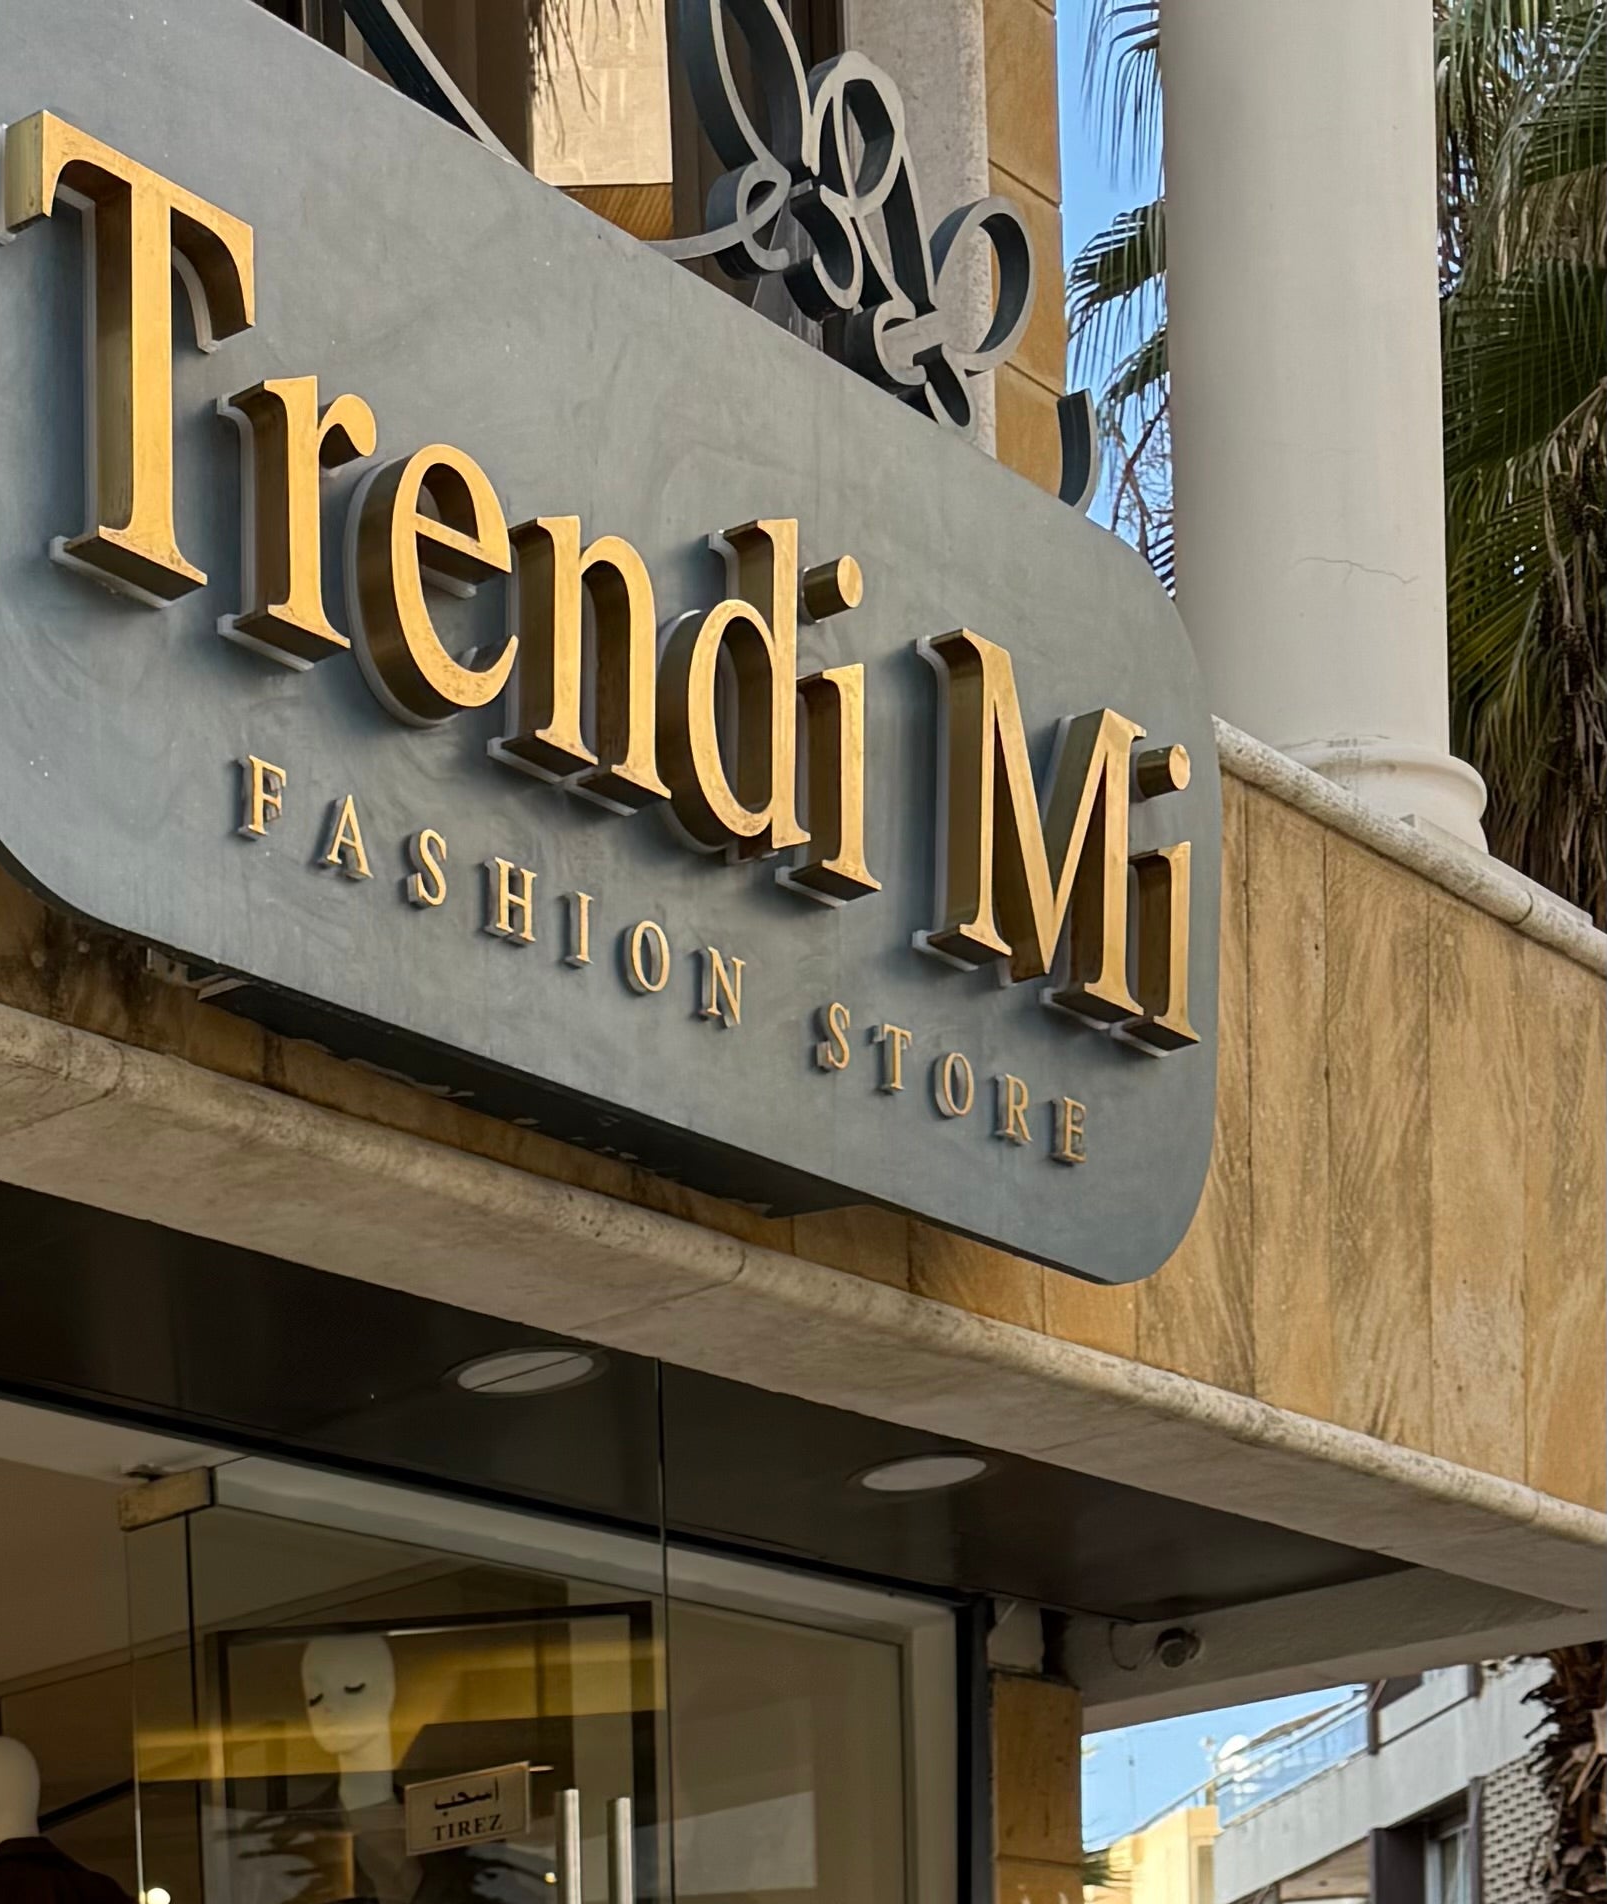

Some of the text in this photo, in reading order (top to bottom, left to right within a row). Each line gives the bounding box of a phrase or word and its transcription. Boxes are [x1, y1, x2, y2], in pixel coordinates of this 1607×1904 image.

[917, 628, 1200, 1052] Mi
[239, 755, 1087, 1164] FASHION STORE
[432, 1813, 504, 1841] TIREZ
[434, 1775, 500, 1817] اسحب
